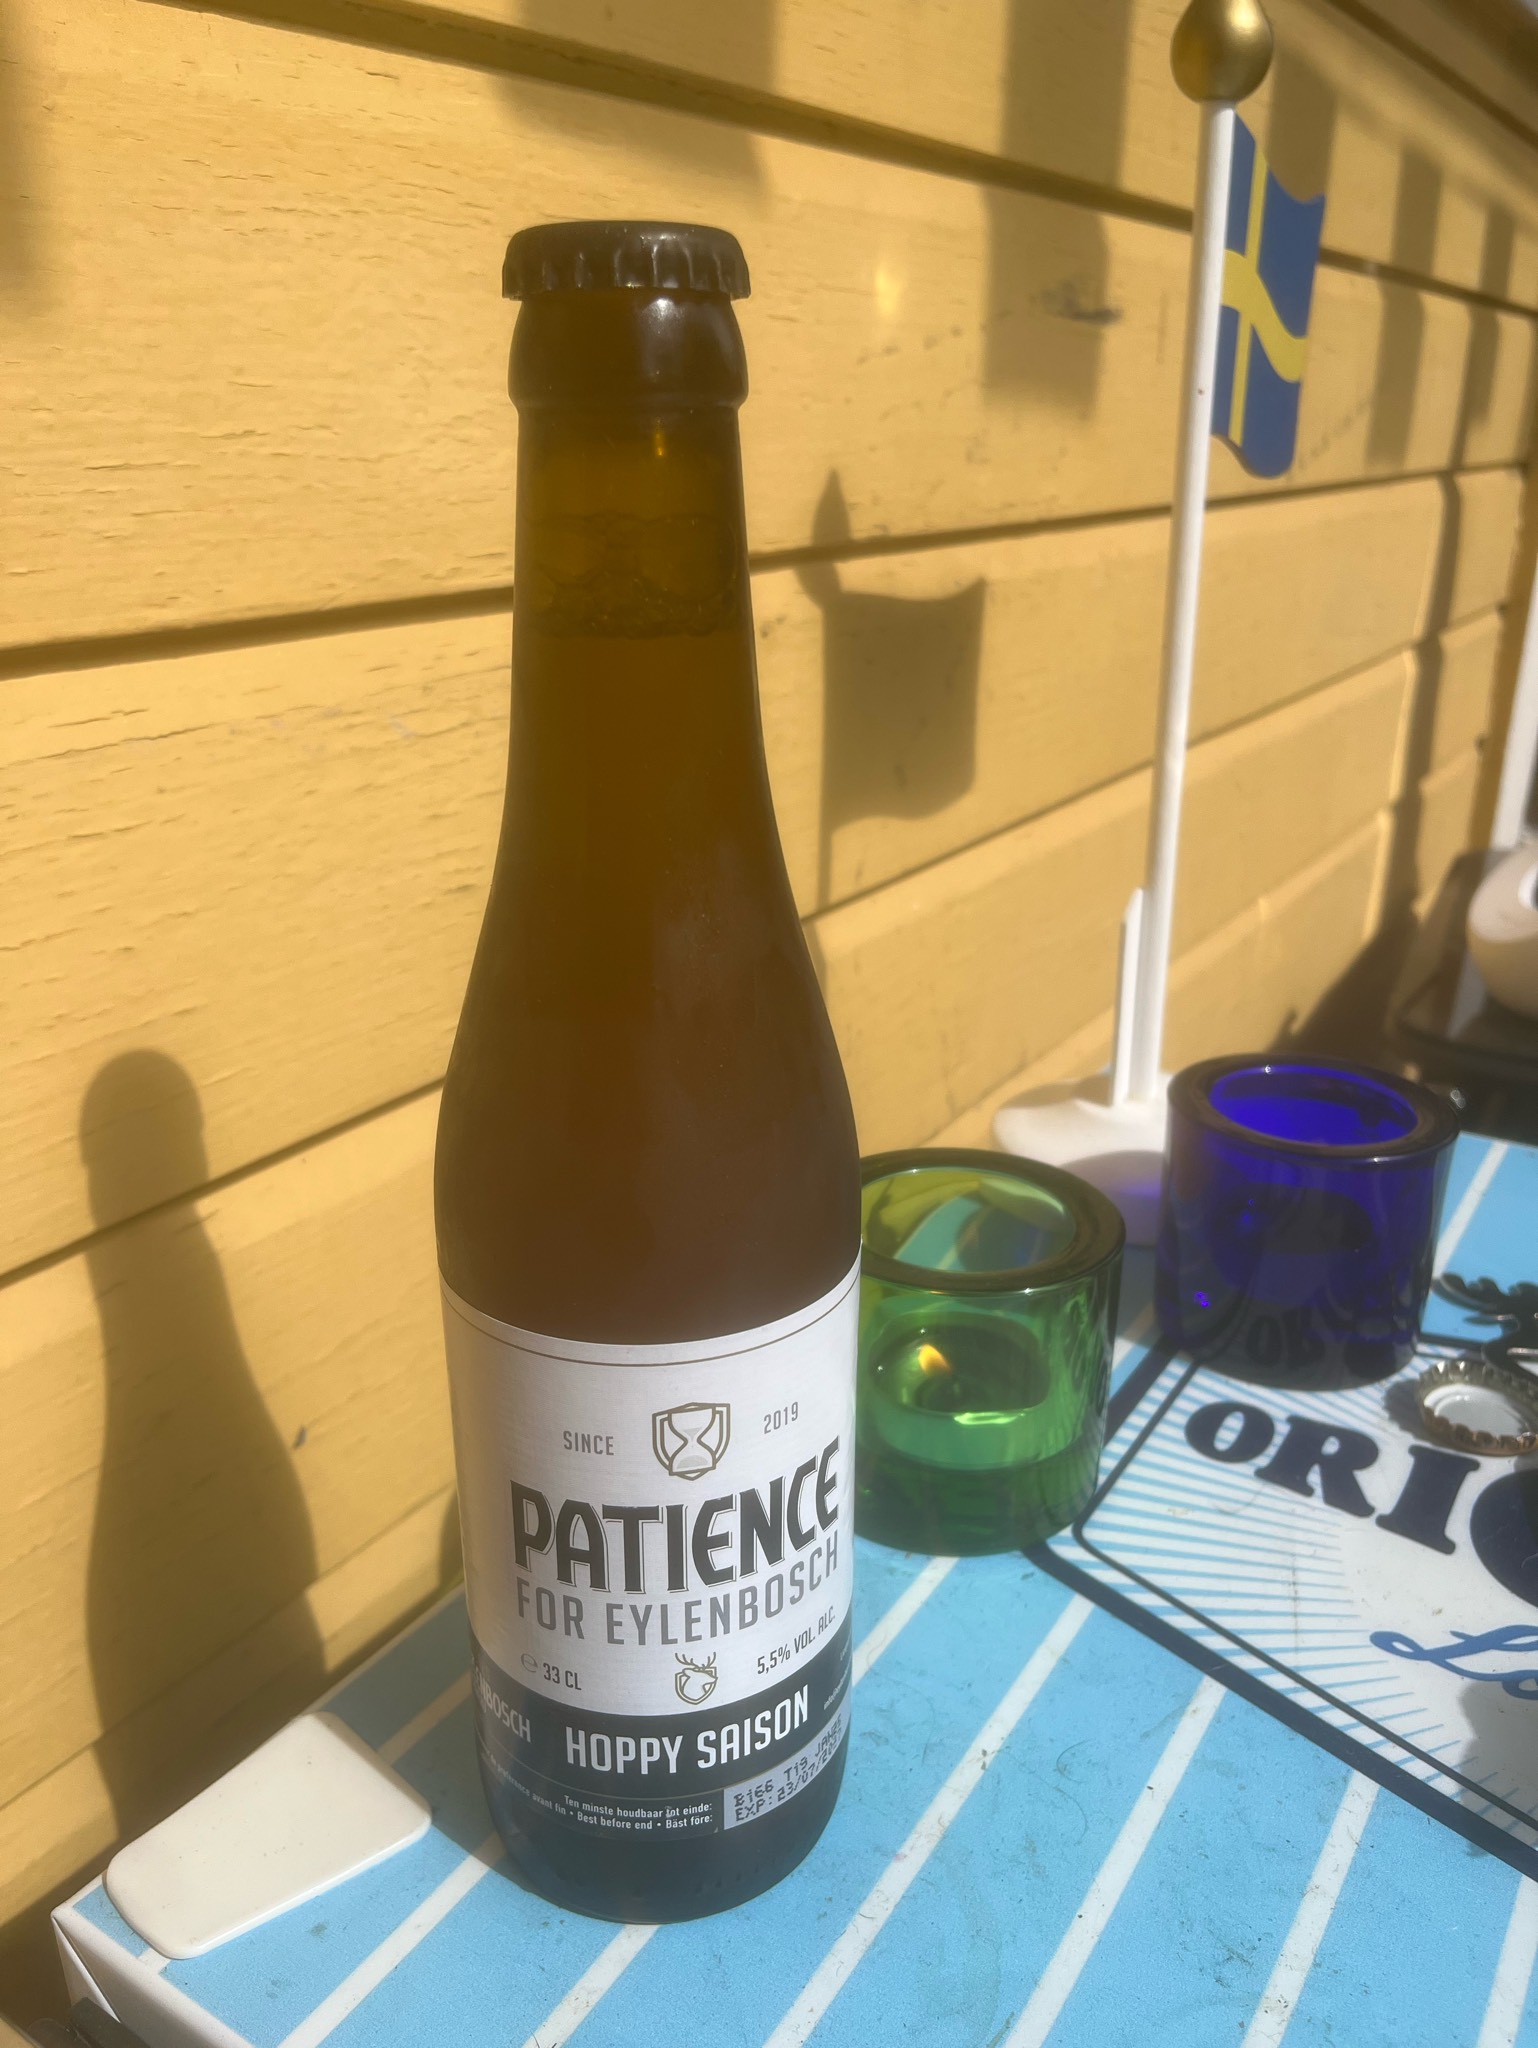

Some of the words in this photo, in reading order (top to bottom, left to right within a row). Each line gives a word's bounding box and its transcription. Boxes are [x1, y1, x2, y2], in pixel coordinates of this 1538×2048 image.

[763, 1401, 799, 1435] 2019
[563, 1430, 615, 1456] SINCE
[510, 1435, 840, 1595] PATIENCE
[516, 1575, 585, 1640] FOR
[606, 1529, 839, 1646] EYLENBOSCH
[757, 1643, 791, 1674] 5,5%
[794, 1627, 816, 1654] VOL.
[818, 1605, 836, 1635] ALC.
[543, 1663, 560, 1684] 33
[565, 1670, 582, 1691] CL
[565, 1725, 684, 1775] HOPPY
[696, 1683, 809, 1769] SAISON
[555, 1803, 566, 1815] fin
[577, 1811, 598, 1825] Best
[600, 1816, 632, 1829] before
[634, 1820, 653, 1830] end
[666, 1818, 688, 1829] Bäst
[690, 1814, 713, 1826] före:
[564, 1795, 580, 1809] Ten
[582, 1801, 614, 1815] minste
[617, 1807, 663, 1818] houdbaar
[683, 1803, 713, 1816] einde:
